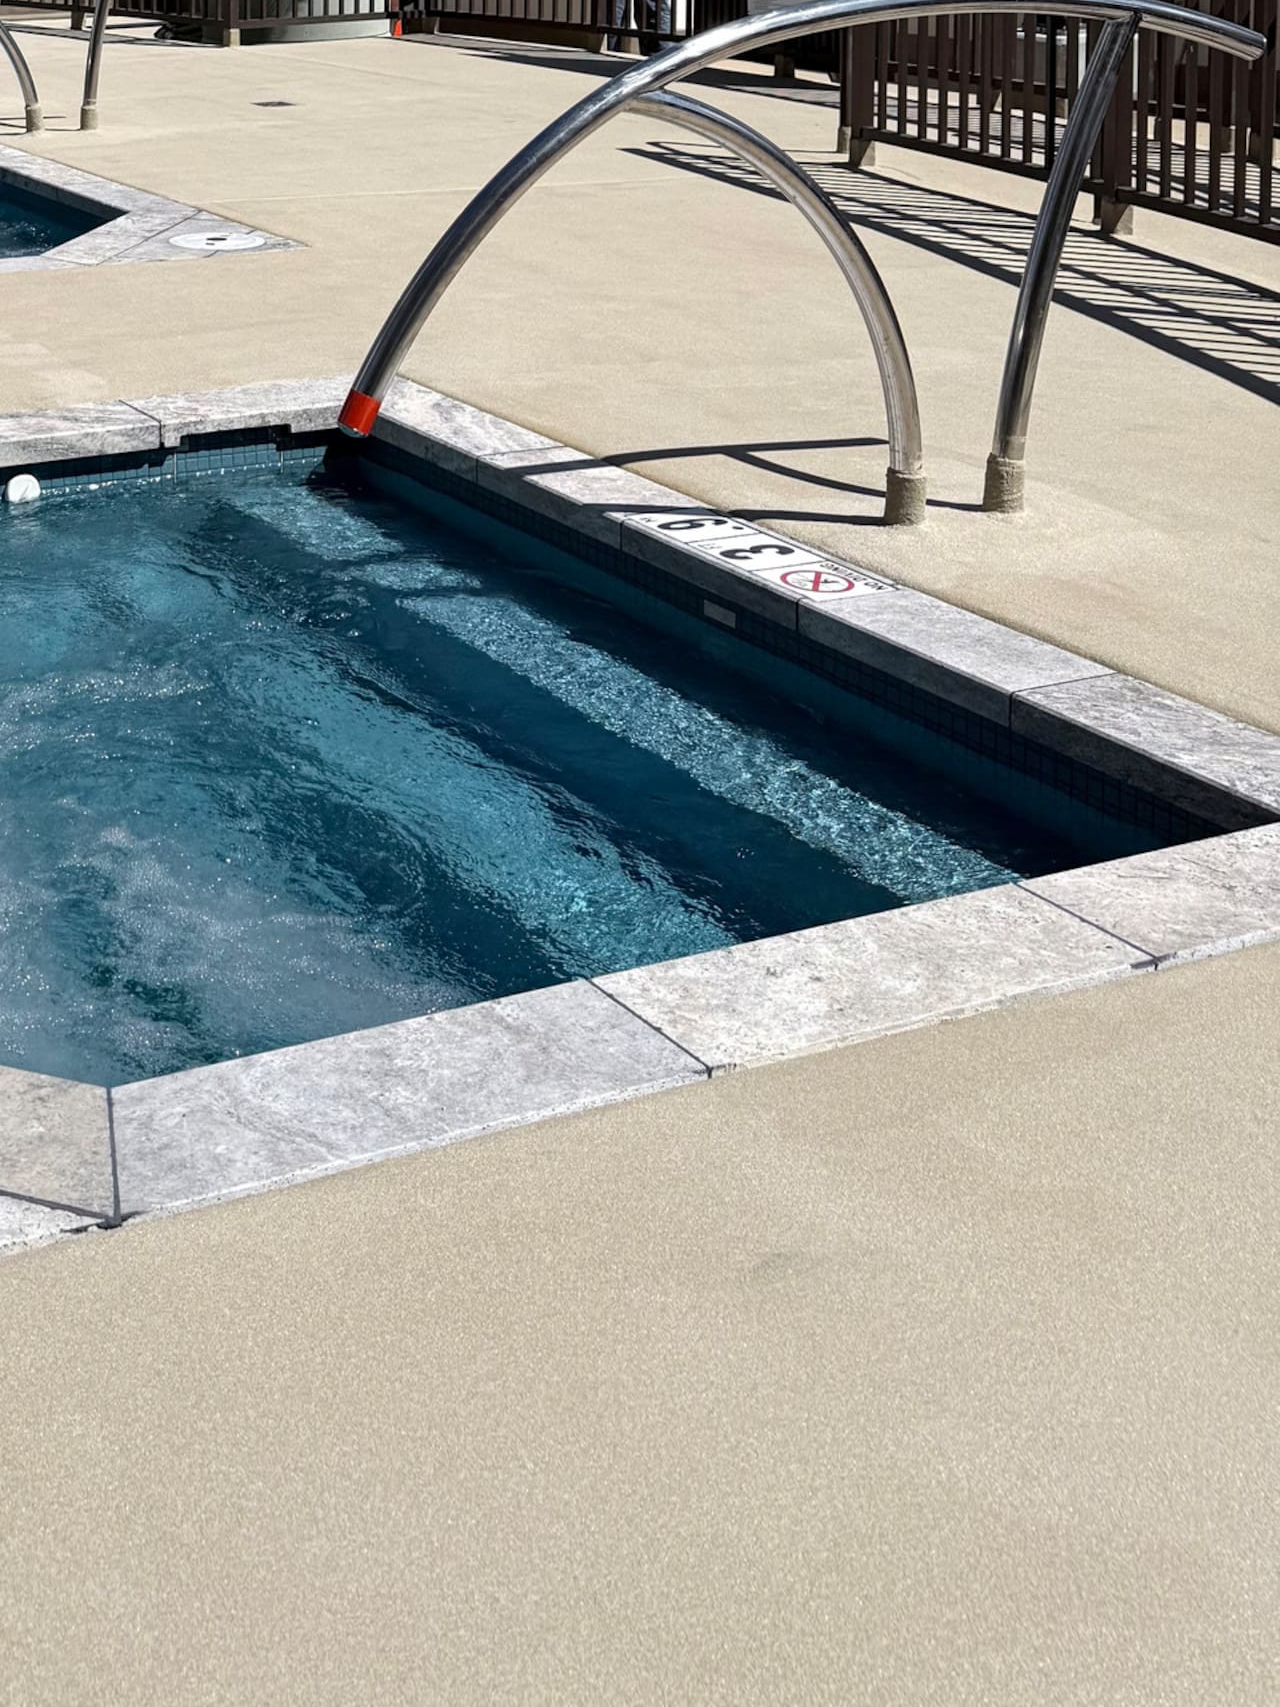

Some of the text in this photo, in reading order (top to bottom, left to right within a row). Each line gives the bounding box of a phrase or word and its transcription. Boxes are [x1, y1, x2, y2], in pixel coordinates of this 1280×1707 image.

[720, 543, 795, 561] 3
[819, 562, 888, 592] NO DIVING
